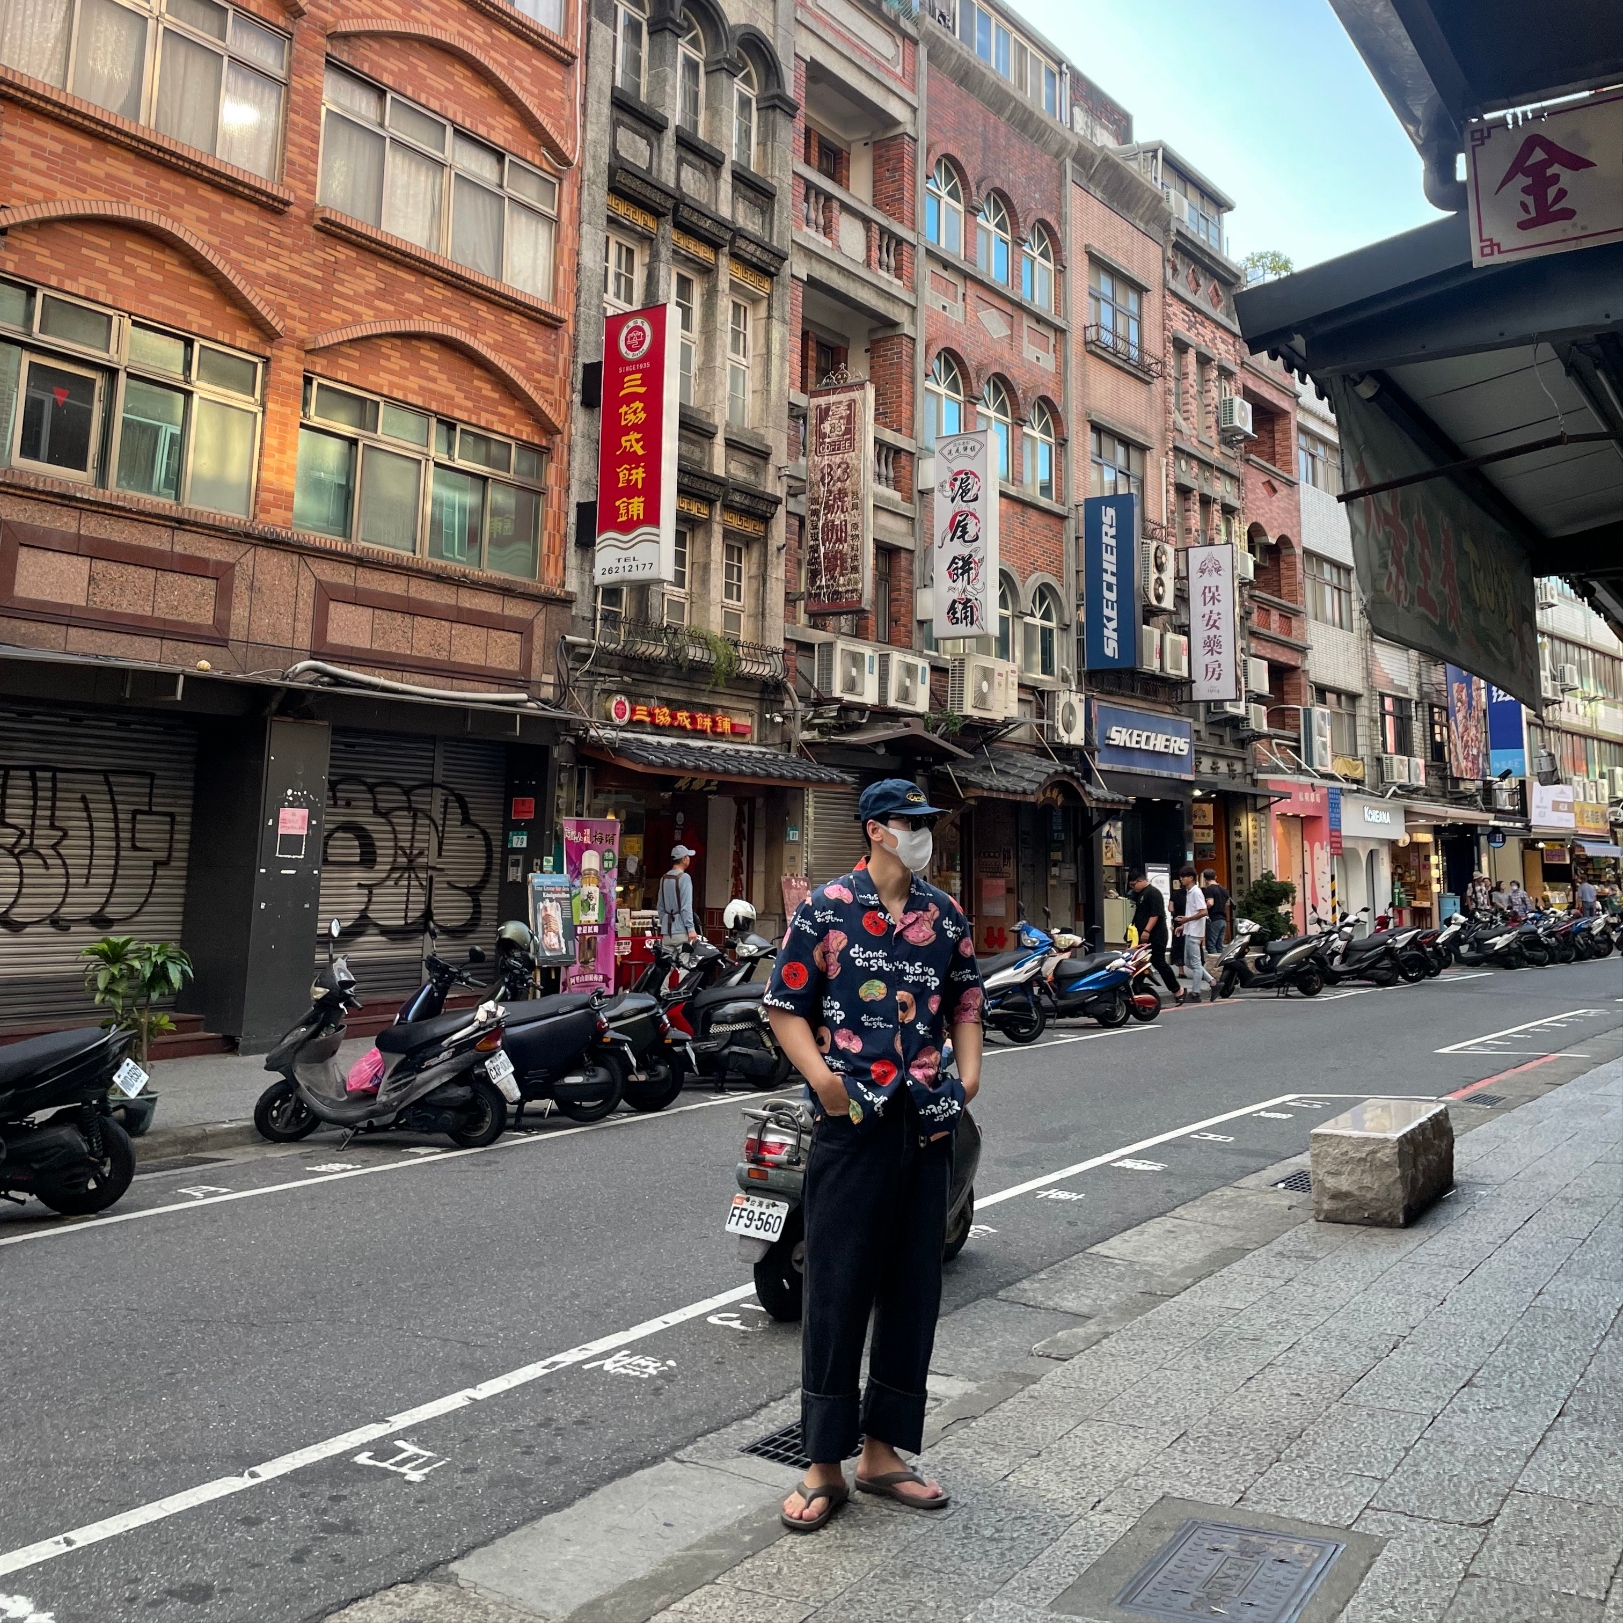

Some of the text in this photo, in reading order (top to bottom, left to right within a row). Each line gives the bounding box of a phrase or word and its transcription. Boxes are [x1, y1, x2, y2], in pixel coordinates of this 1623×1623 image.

[1494, 133, 1598, 231] 金
[820, 439, 851, 454] COFFEE
[601, 562, 654, 576] 26212177
[616, 556, 640, 564] TEL
[1101, 505, 1119, 660] SKECHERS
[1200, 584, 1224, 682] 保安藥房
[1109, 725, 1191, 756] SKECHERS
[515, 837, 525, 847] 79
